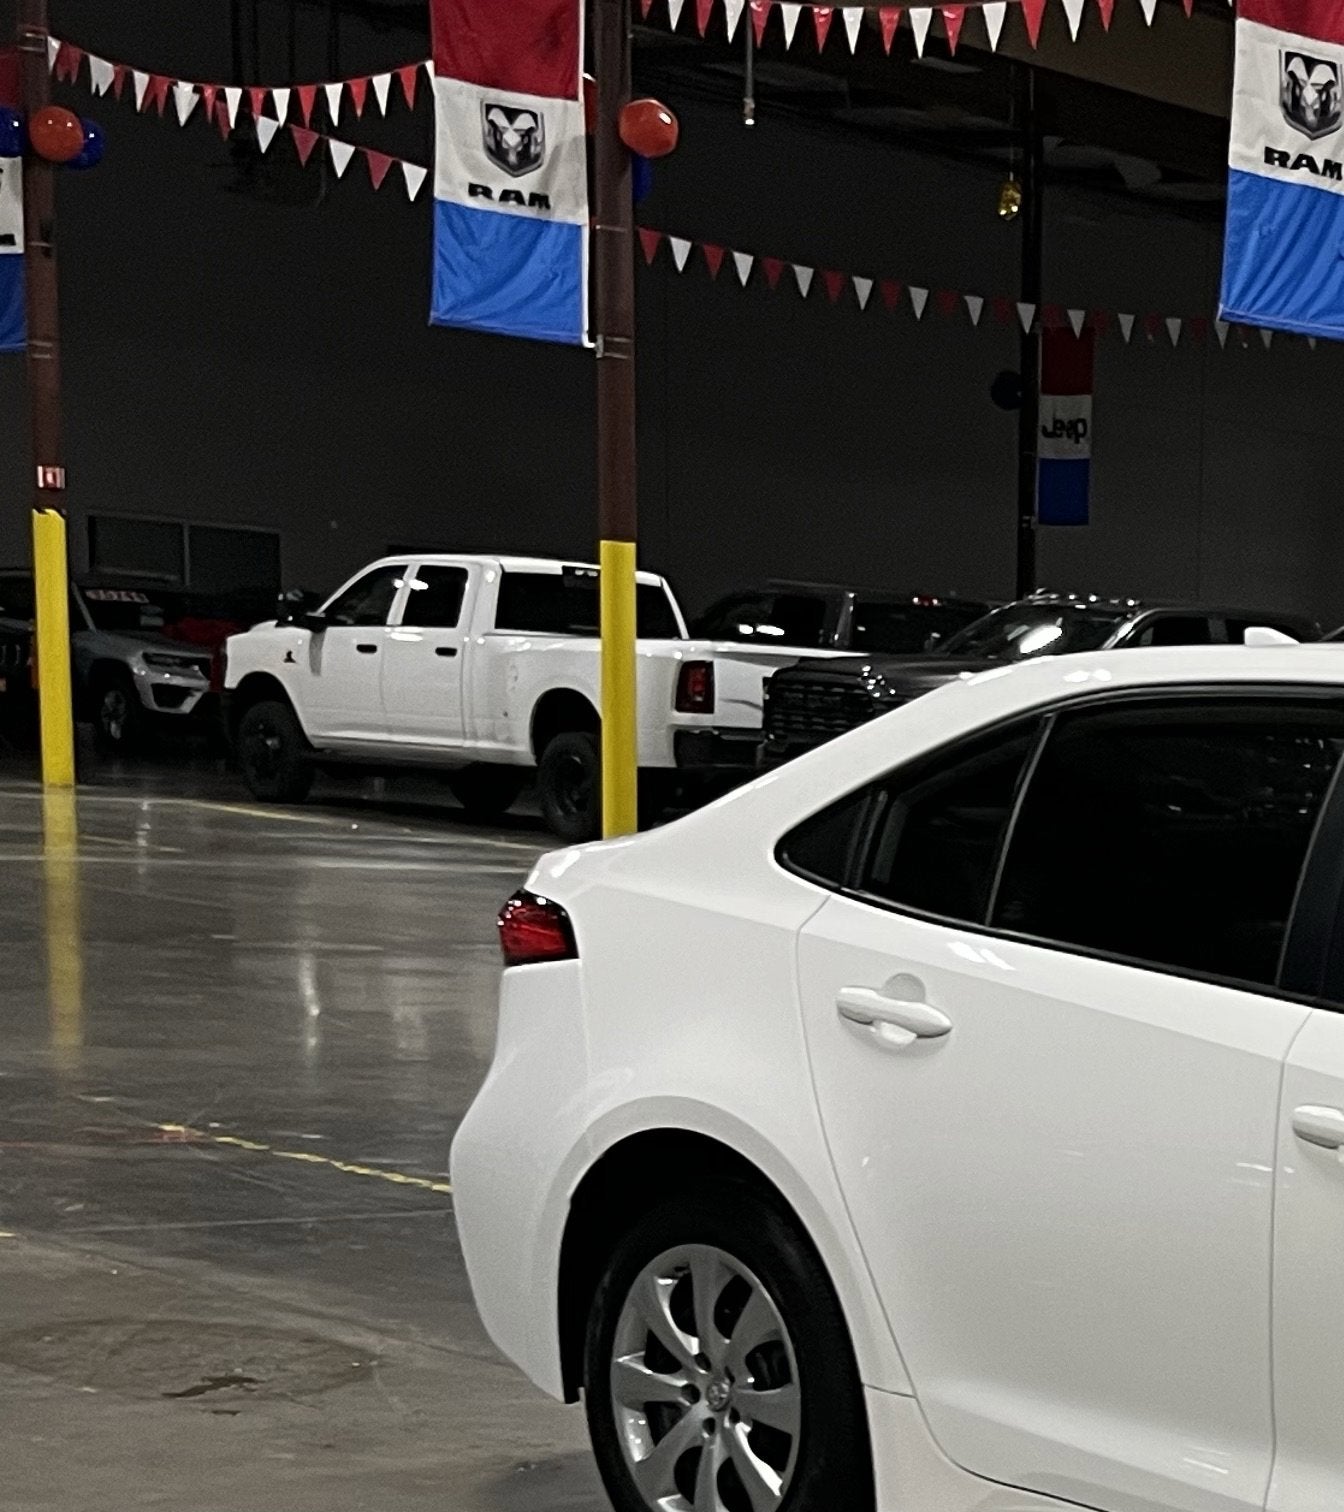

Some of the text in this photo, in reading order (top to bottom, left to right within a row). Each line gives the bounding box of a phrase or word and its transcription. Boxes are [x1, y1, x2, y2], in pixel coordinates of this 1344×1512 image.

[1263, 146, 1343, 181] RAM
[468, 182, 551, 210] RAM
[1041, 416, 1088, 445] Jeep
